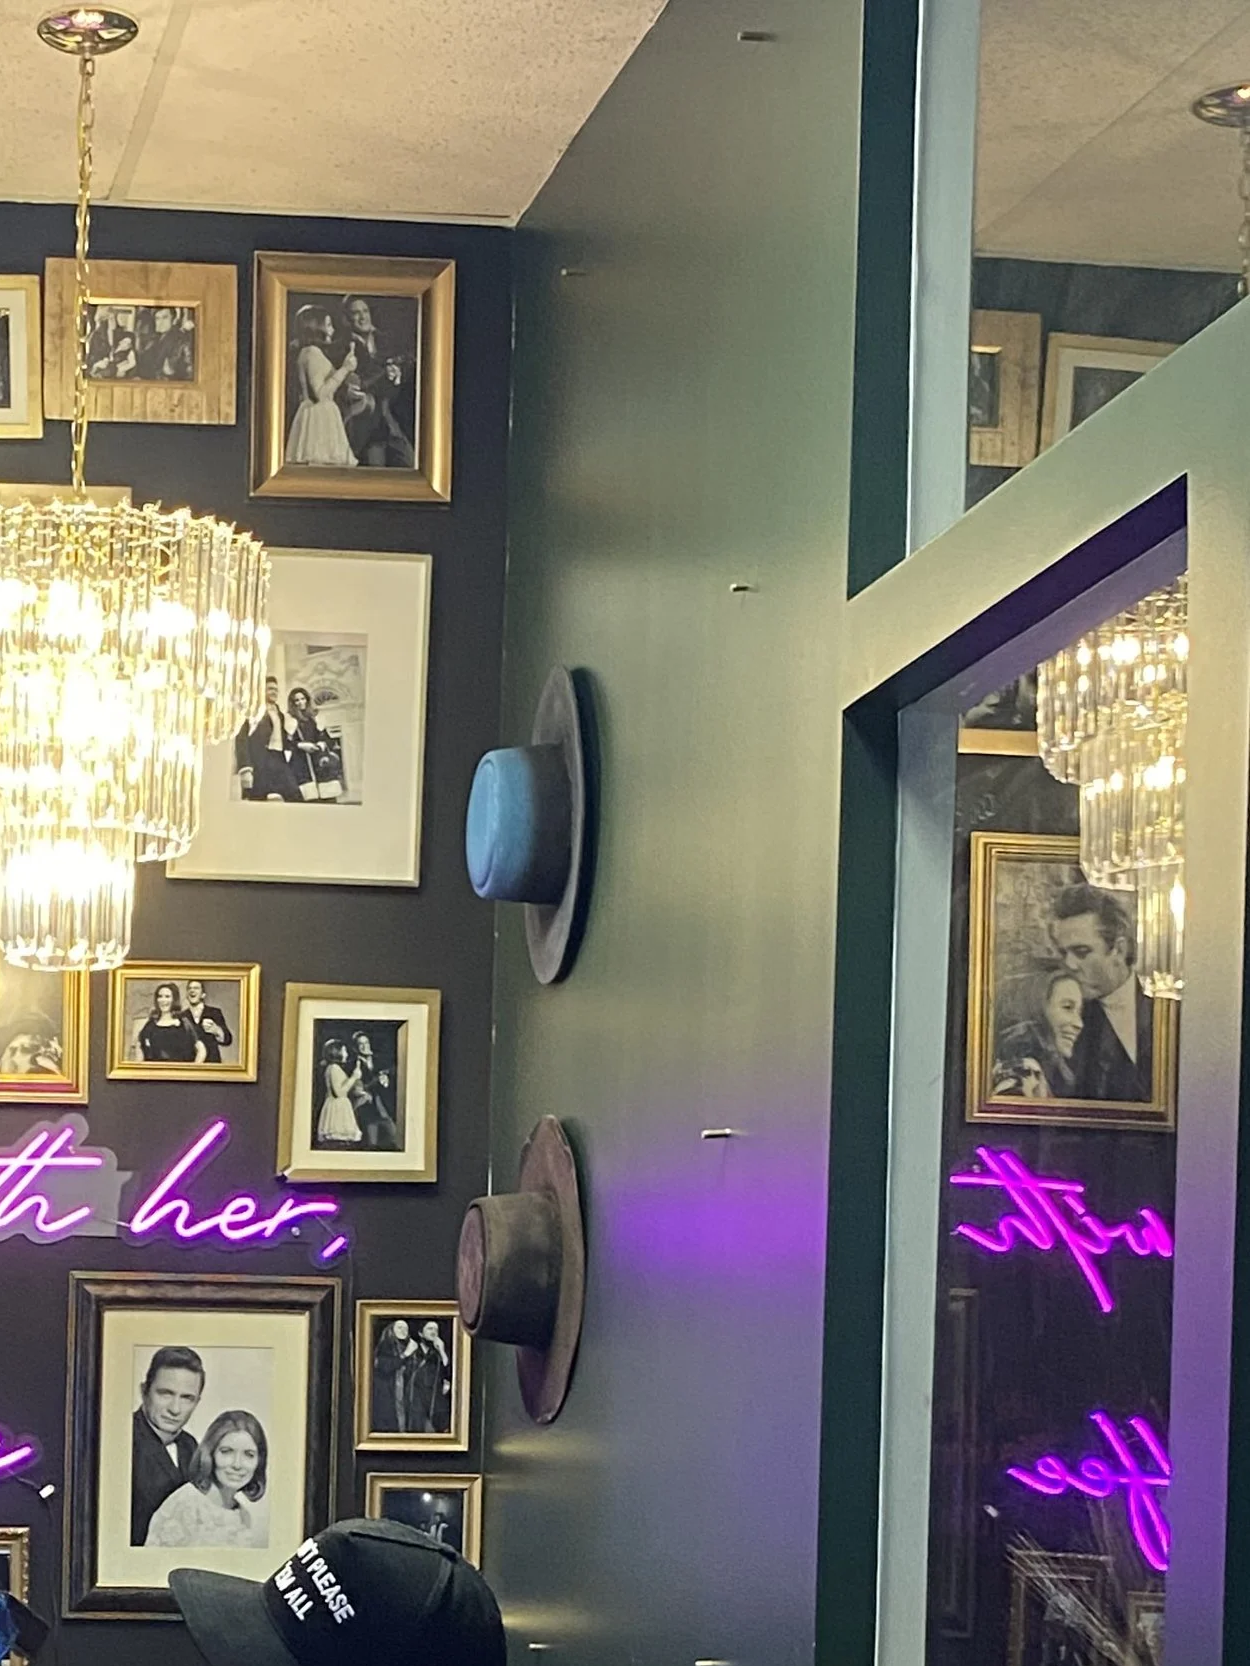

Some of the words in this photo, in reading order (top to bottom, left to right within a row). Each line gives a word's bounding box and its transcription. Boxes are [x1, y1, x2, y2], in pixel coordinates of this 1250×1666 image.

[129, 1119, 348, 1258] her,
[282, 1586, 314, 1621] ALL
[306, 1557, 356, 1625] PLEASE
